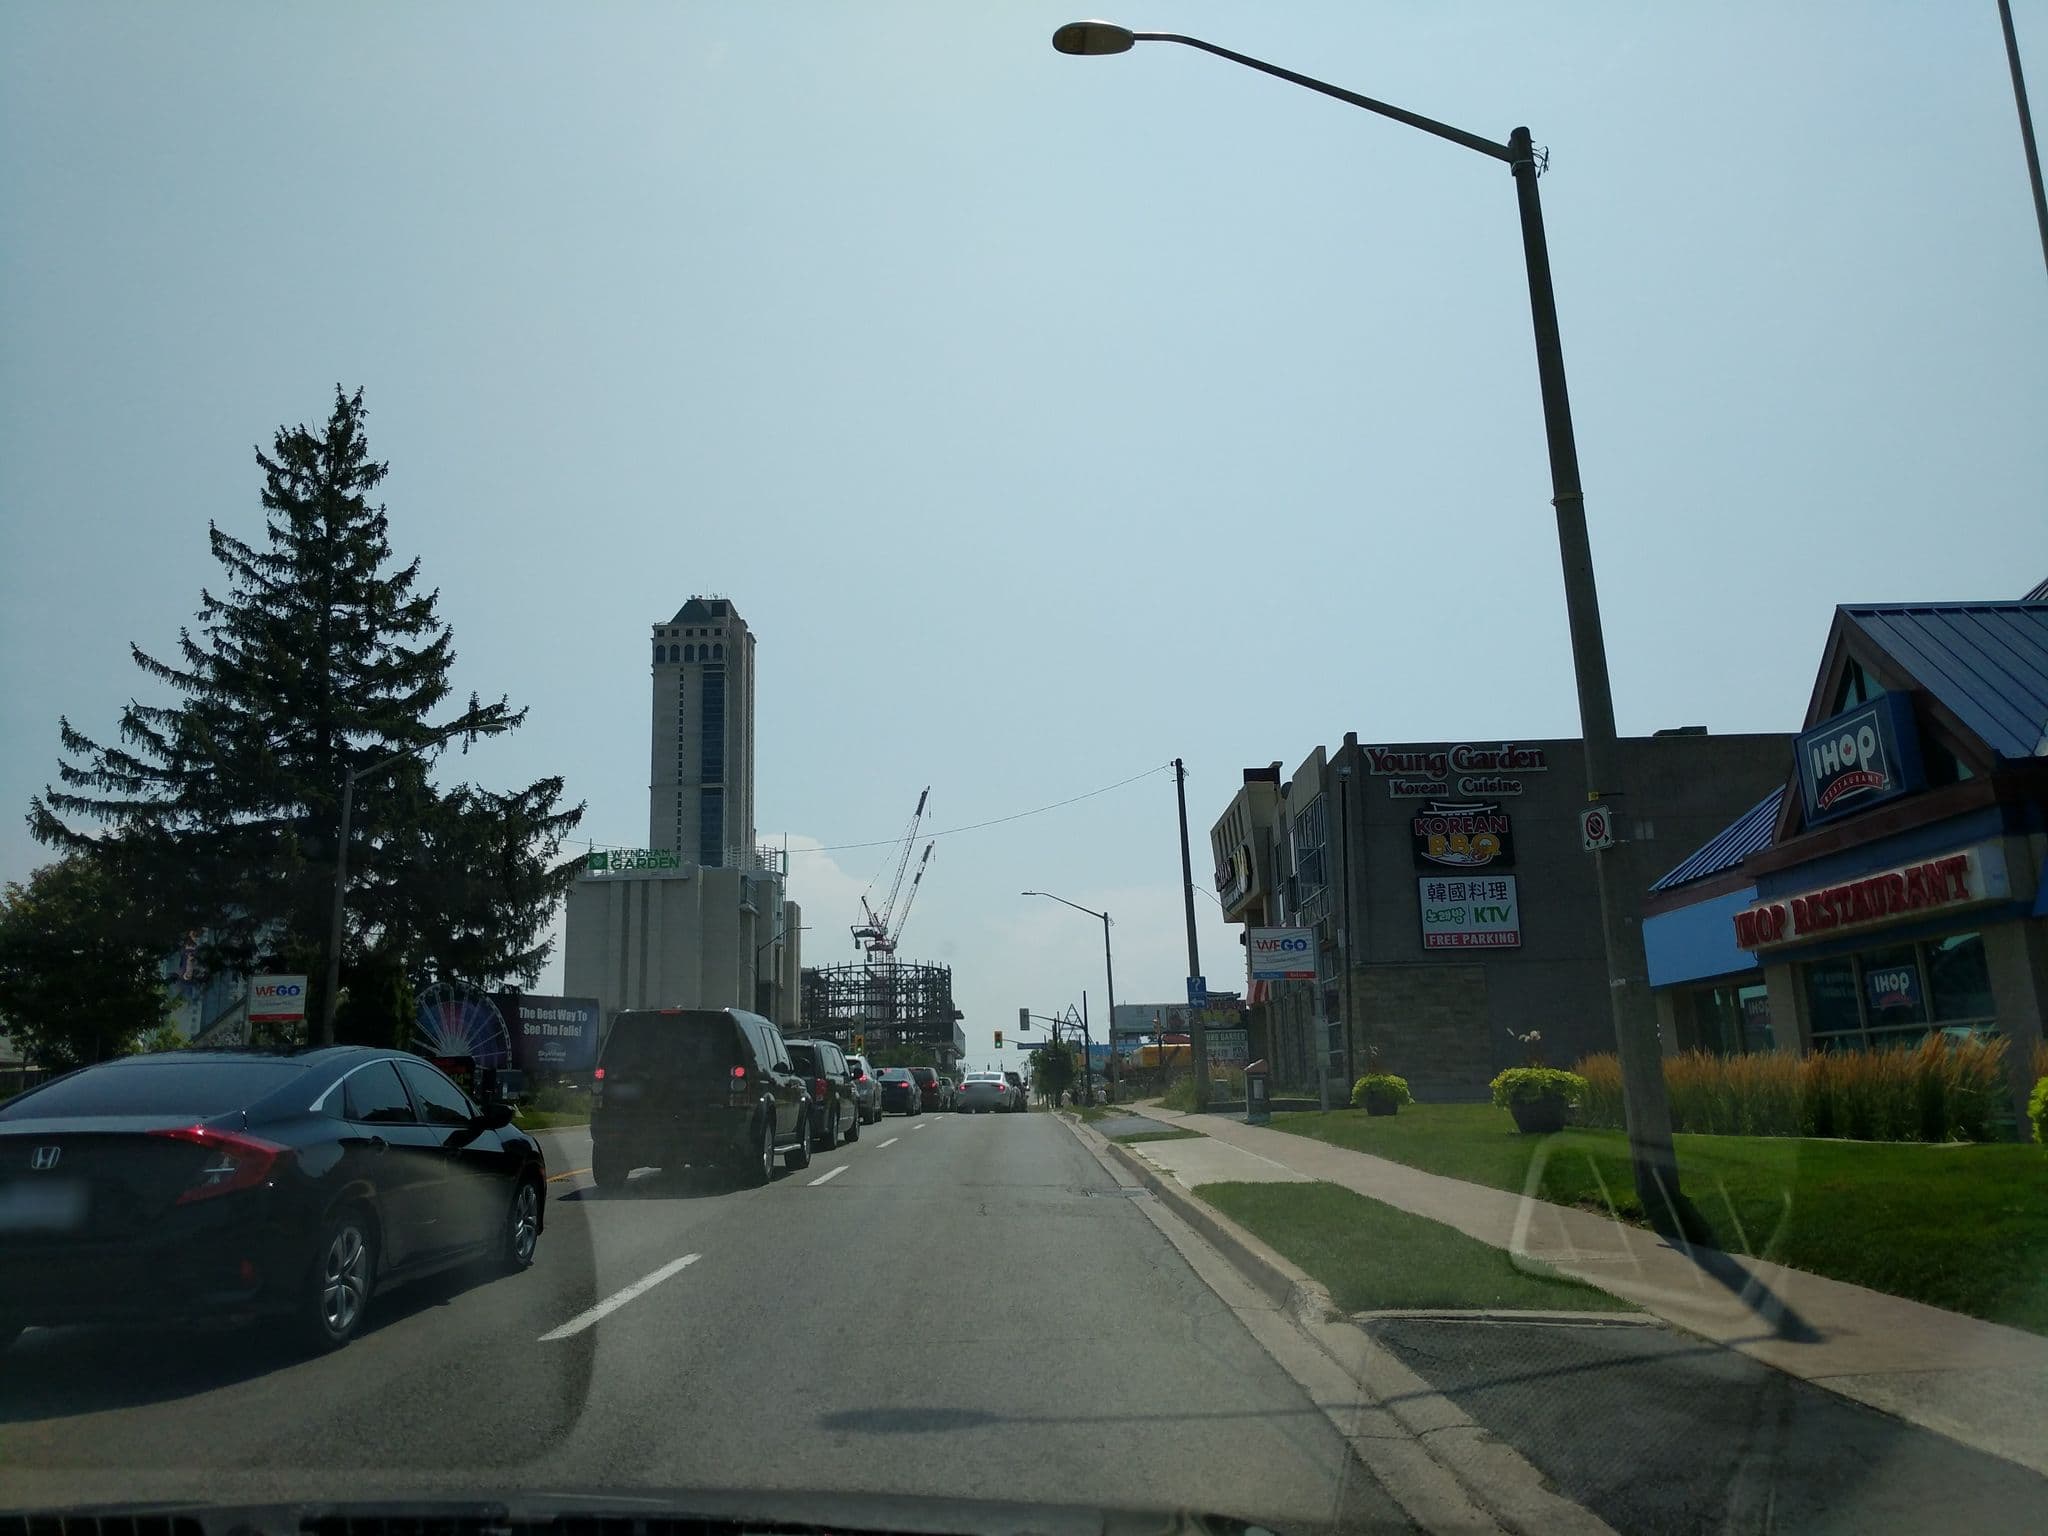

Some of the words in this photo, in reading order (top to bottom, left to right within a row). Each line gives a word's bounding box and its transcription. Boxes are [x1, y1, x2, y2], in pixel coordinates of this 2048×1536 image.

[1364, 747, 1448, 780] Young
[1451, 744, 1547, 772] Garden
[1813, 725, 1876, 779] IHOP
[1392, 779, 1448, 796] Korean
[1460, 777, 1521, 794] Cuisine
[1824, 774, 1880, 804] RESTAURANT
[1414, 816, 1509, 836] KOREAN
[611, 848, 672, 859] WYNDHAM
[1428, 833, 1502, 857] BBQ
[610, 857, 681, 870] GARDEN
[1427, 881, 1508, 903] 韓國料理
[1733, 904, 1786, 949] IHOP
[1790, 854, 1970, 935] RESTAURANT
[1425, 906, 1466, 925] 노래방
[1473, 904, 1513, 924] KTV
[1428, 934, 1459, 946] FREE
[1462, 931, 1515, 945] PARKING
[1874, 972, 1910, 996] IHOP
[519, 1007, 536, 1019] The
[537, 1008, 557, 1020] Best
[557, 1009, 577, 1022] Way
[577, 1010, 588, 1021] To
[523, 1023, 541, 1035] See
[542, 1024, 558, 1036] The
[559, 1025, 582, 1037] Falls!
